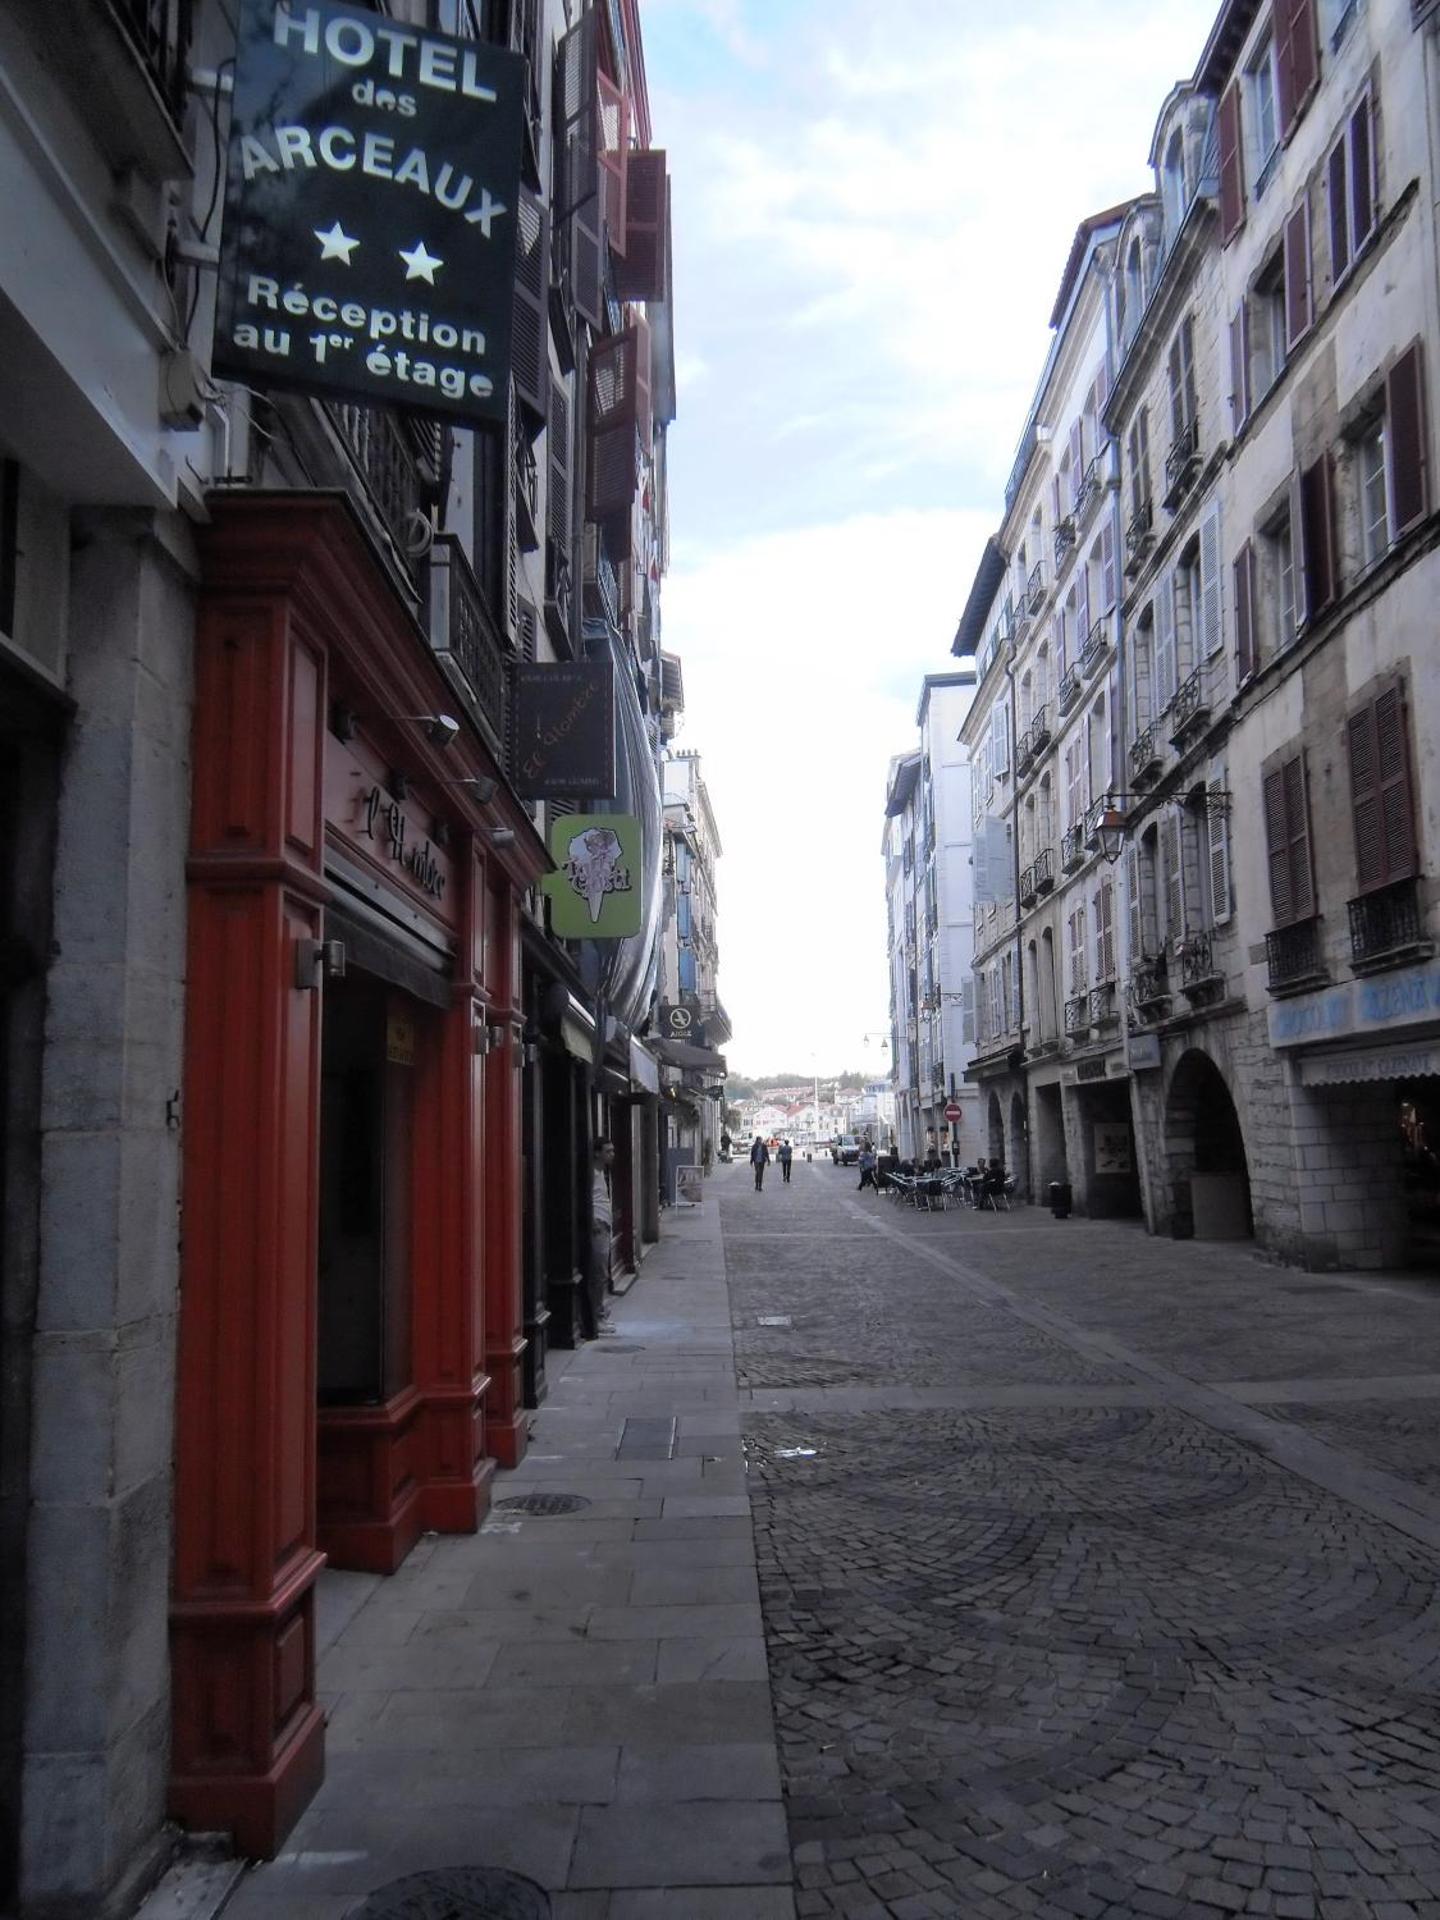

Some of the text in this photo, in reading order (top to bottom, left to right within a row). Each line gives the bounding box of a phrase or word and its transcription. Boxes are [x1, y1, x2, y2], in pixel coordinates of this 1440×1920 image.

[273, 2, 497, 103] HOTEL
[351, 78, 418, 118] des
[240, 124, 507, 240] ARCEAUX
[247, 273, 487, 356] Réception
[232, 323, 494, 399] au 1er étage
